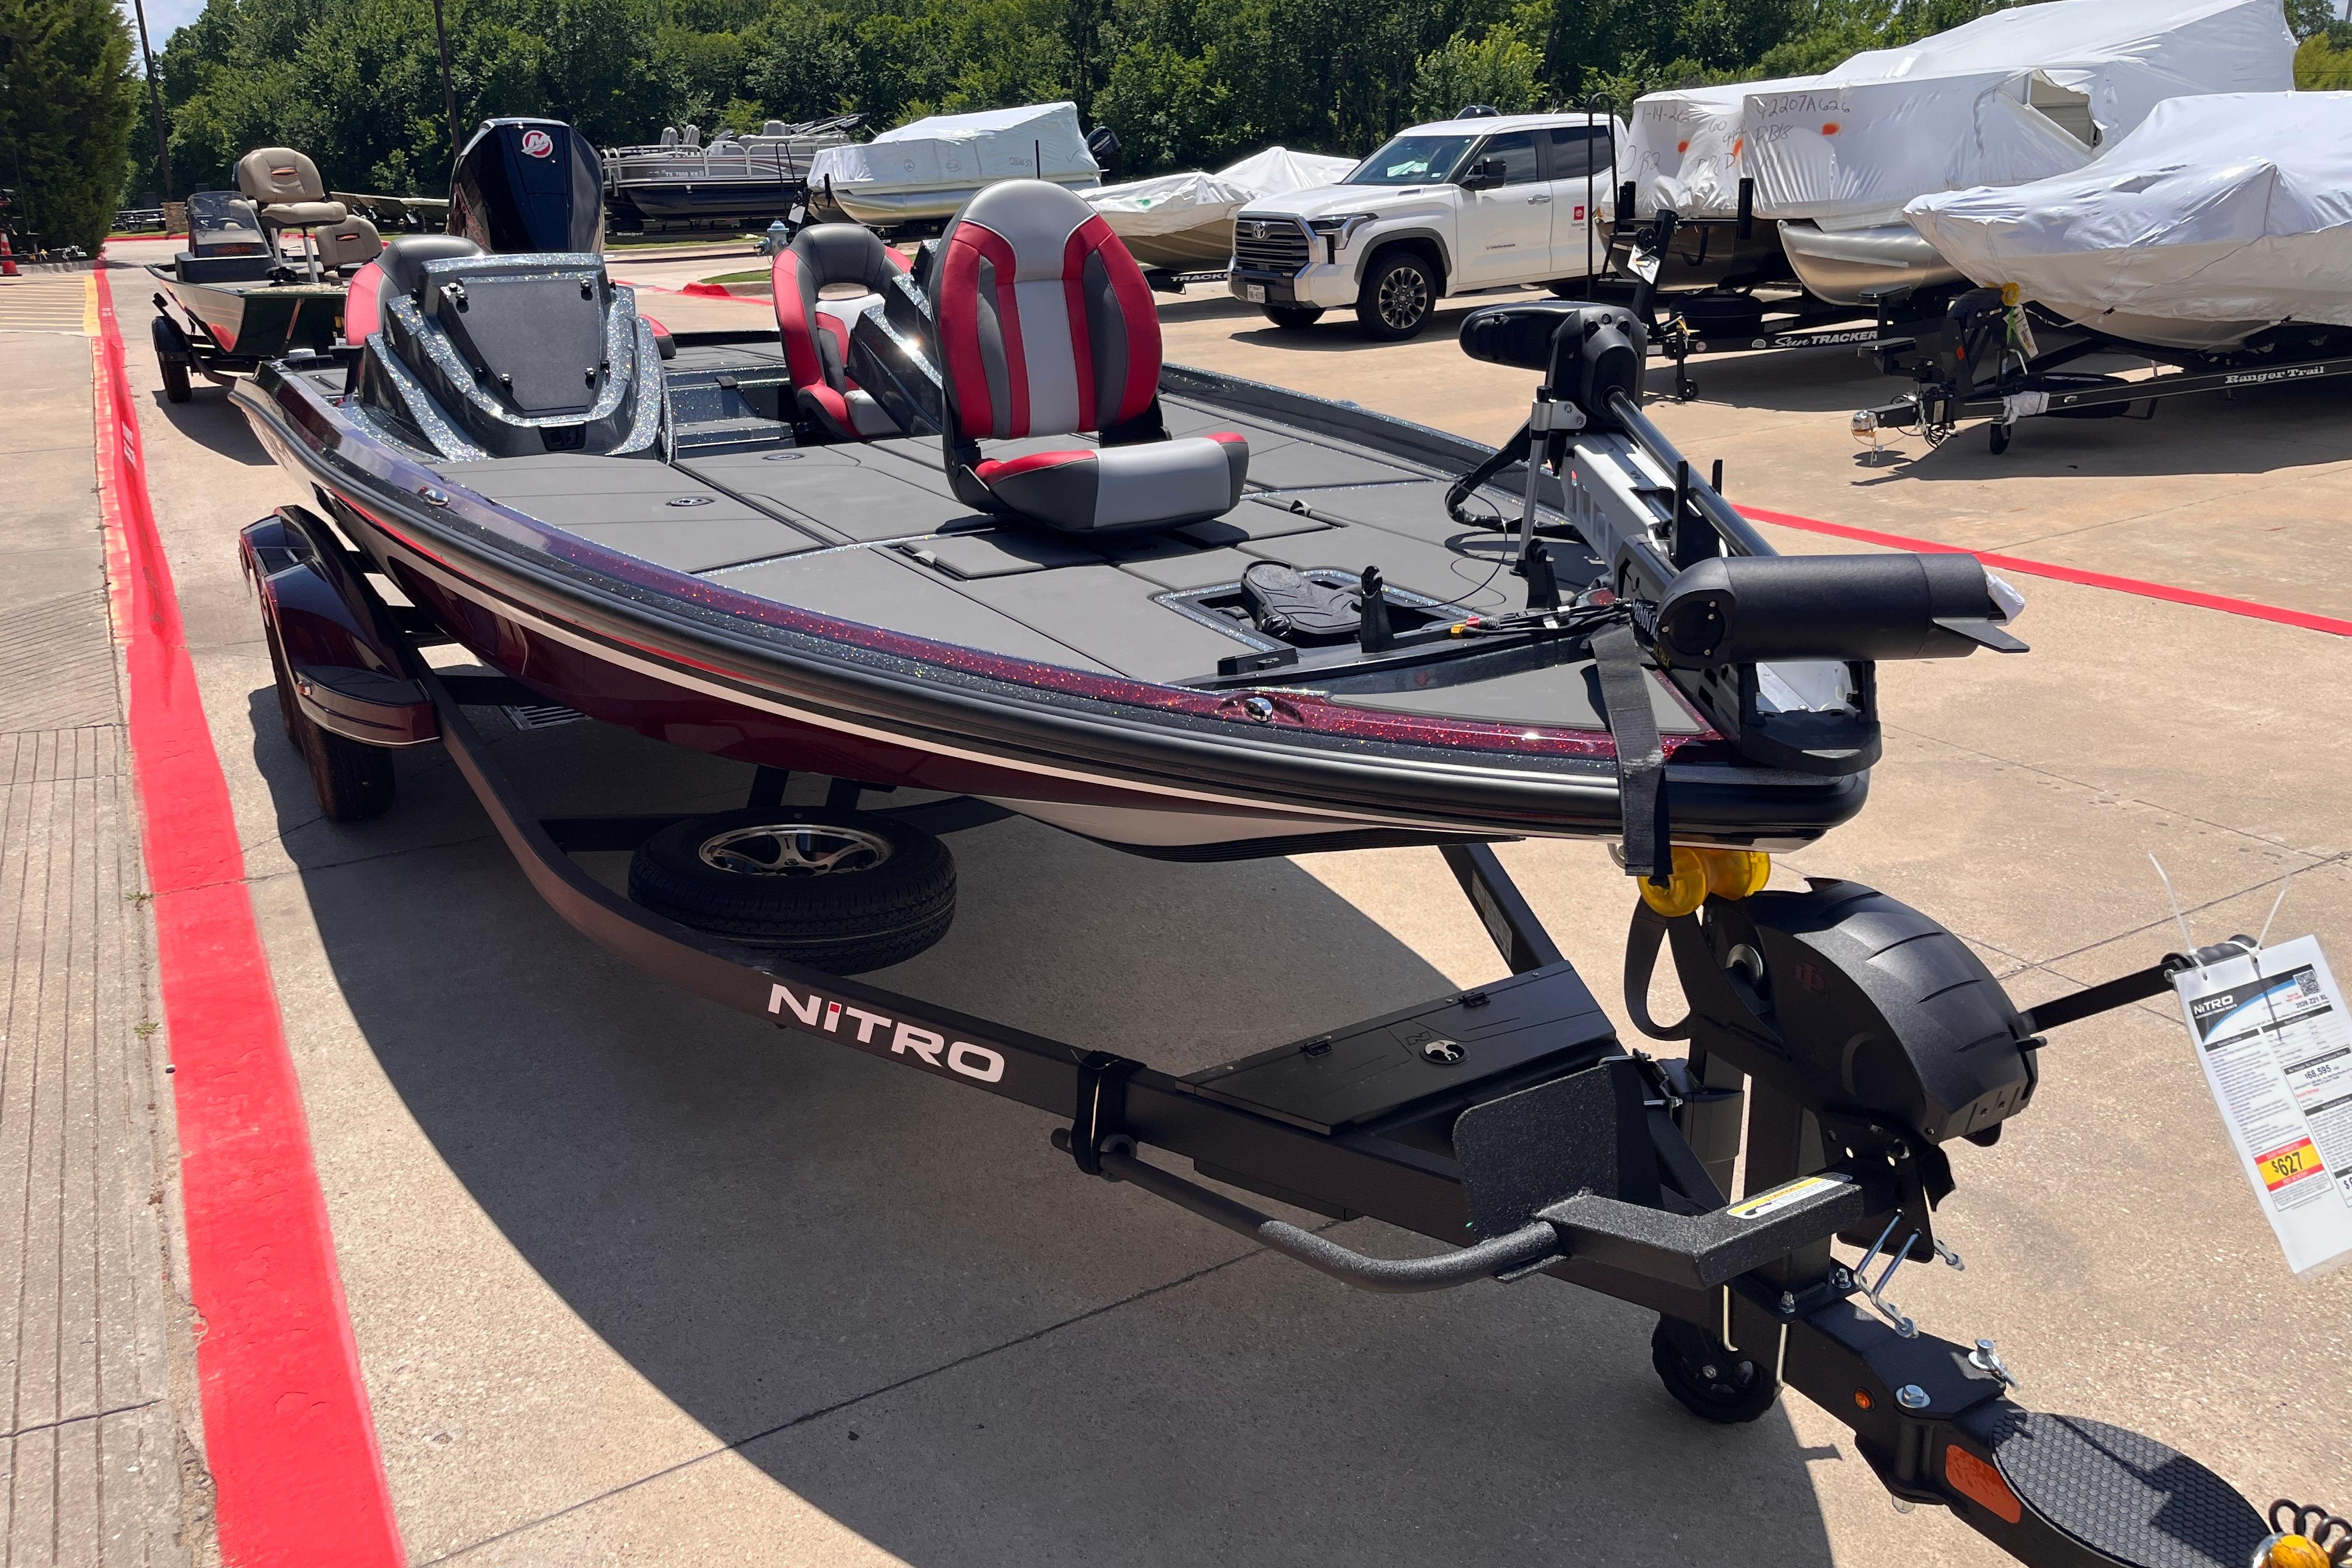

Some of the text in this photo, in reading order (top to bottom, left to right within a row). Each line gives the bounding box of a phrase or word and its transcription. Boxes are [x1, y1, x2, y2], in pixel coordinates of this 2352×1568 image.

[1171, 273, 1227, 282] TRACK
[1770, 331, 1877, 348] Sun TRACKER
[2225, 366, 2325, 384] Ranger Trail
[2305, 1065, 2332, 1080] $68,595
[2271, 1151, 2303, 1176] $627
